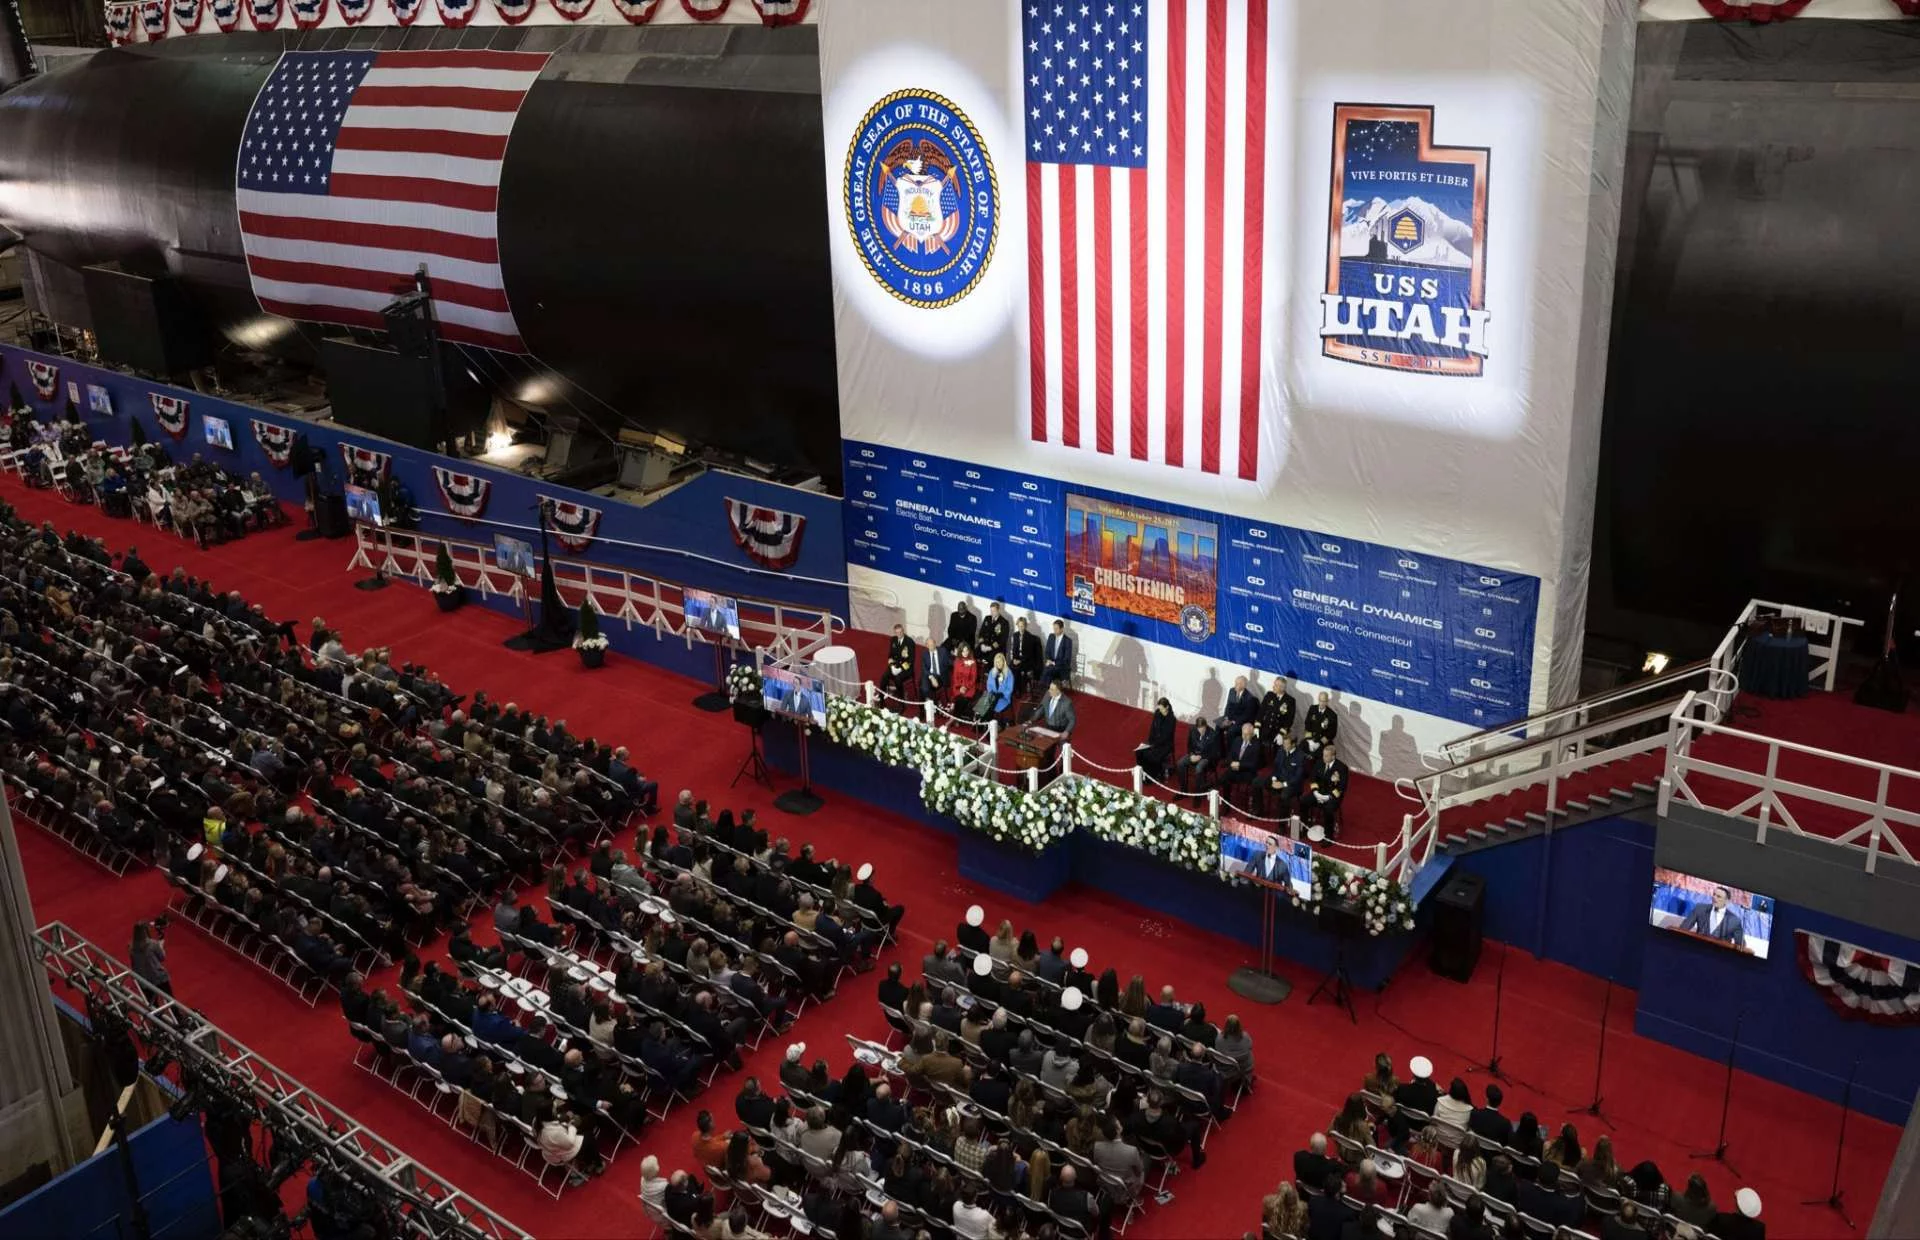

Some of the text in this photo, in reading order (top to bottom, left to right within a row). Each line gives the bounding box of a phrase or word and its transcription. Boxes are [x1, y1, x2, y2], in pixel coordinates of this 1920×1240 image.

[1351, 171, 1469, 188] VIVE FORTIS ET LIBER
[854, 103, 989, 277] THE GREAT SEAL OF THE STATE OF UTAH
[909, 222, 931, 232] UTAH
[903, 278, 944, 297] 1896
[1374, 273, 1439, 299] USS
[1320, 292, 1491, 359] UTAH
[895, 499, 943, 516] GENERAL
[944, 510, 1001, 529] DYNAMICS
[941, 529, 982, 545] Connecticut
[1249, 528, 1267, 538] GD
[1321, 543, 1341, 553] GD
[1398, 559, 1419, 570] GD
[1094, 567, 1185, 605] CHRISTENING
[1247, 576, 1265, 586] GD
[1480, 576, 1501, 587] GD
[1292, 598, 1343, 618] Electric Boat
[1292, 588, 1443, 630] GENERAL DYNAMICS
[1245, 622, 1264, 633] GD
[1317, 618, 1412, 648] Groton, Connecticut
[1474, 627, 1496, 639] GD
[1316, 640, 1335, 651] GD
[1390, 658, 1411, 670] GD
[1470, 678, 1492, 689] GD
